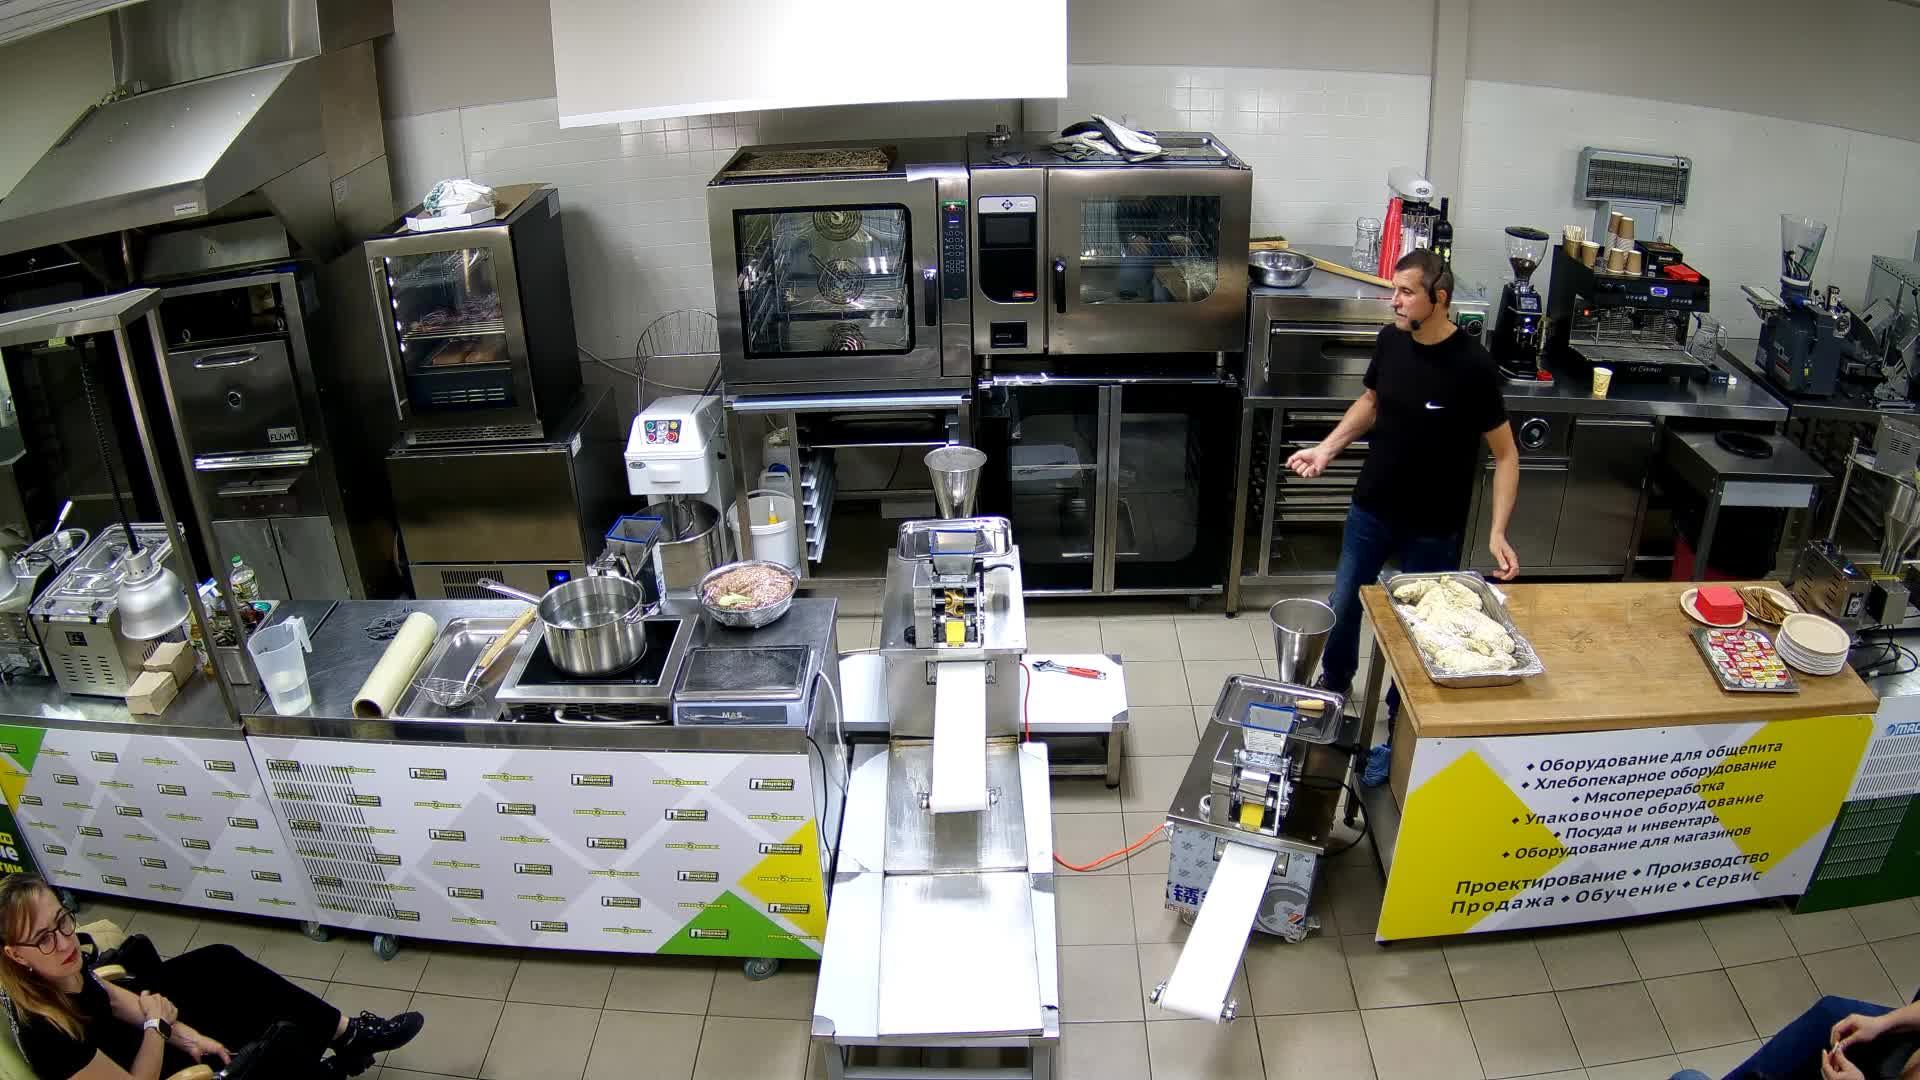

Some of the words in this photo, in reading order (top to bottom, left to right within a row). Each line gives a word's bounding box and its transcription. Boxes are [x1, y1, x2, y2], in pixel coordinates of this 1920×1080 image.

[1539, 754, 1668, 772] Оборудование
[1671, 750, 1702, 764] для
[1706, 742, 1783, 759] общепита
[1534, 771, 1666, 790] Хлебопекарное
[1670, 760, 1777, 779] оборудование
[1584, 781, 1725, 804] Мясопереработка
[1525, 807, 1643, 825] Упаковочное
[1647, 793, 1764, 815] оборудование
[1515, 840, 1638, 859] Оборудование
[1639, 836, 1670, 849] для
[1673, 826, 1751, 844] магазинов
[1565, 825, 1622, 840] Посуда
[1627, 823, 1637, 833] и
[1641, 815, 1720, 832] инвентарь
[1456, 869, 1627, 896] Проектирование
[1646, 852, 1769, 878] Производство
[1451, 895, 1555, 916] Продажа
[1576, 881, 1677, 903] Обучение
[1695, 870, 1763, 888] Сервис
